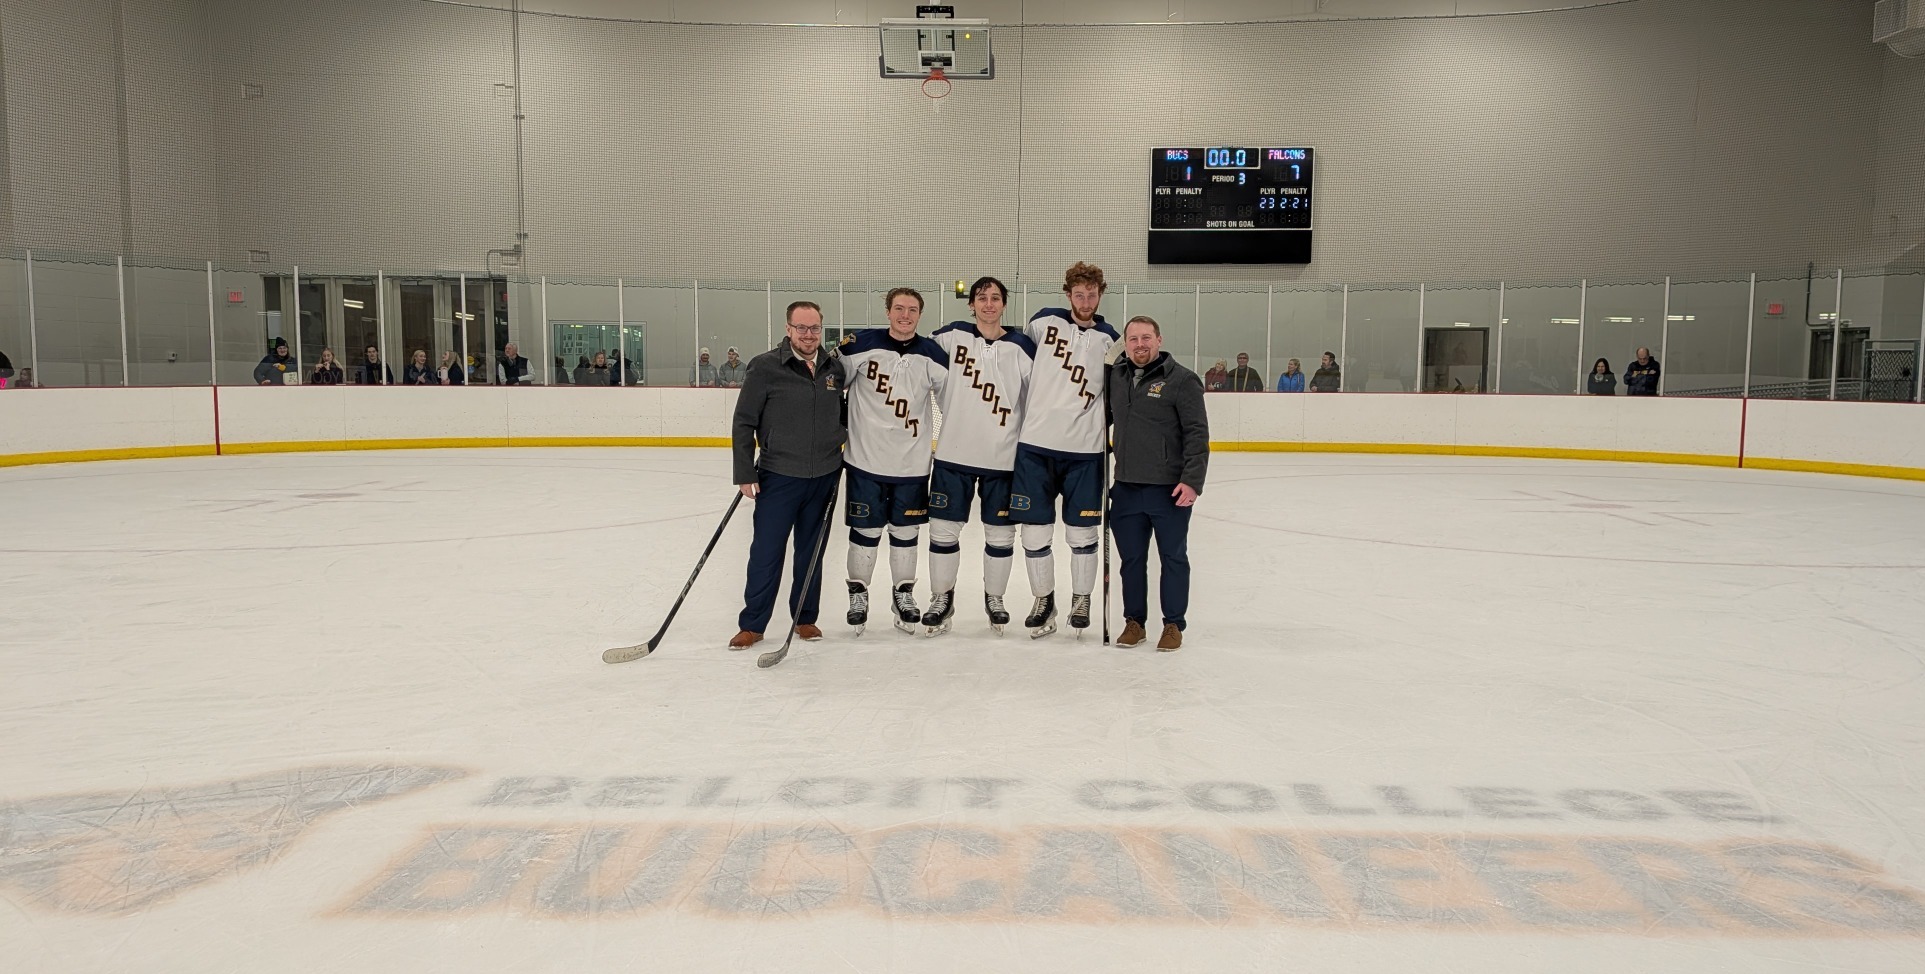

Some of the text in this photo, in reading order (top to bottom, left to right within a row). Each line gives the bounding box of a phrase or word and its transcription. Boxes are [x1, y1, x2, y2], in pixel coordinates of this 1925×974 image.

[1167, 150, 1189, 160] BUCS
[1208, 149, 1246, 166] 00.0
[1268, 149, 1306, 160] FALCONS
[1186, 166, 1192, 181] 1
[1211, 172, 1246, 185] PERIOD 3
[1291, 164, 1300, 180] 7
[1155, 187, 1202, 195] PLYR PENALTY
[1260, 187, 1308, 195] PLYR PENALTY
[1259, 197, 1308, 209] 23 2:21
[1206, 220, 1255, 228] SHOTS ON GOAL
[1044, 325, 1096, 410] BELOIT
[954, 345, 1011, 427] BELOIT
[866, 360, 919, 438] BELOIT
[929, 492, 948, 508] B
[1010, 493, 1031, 511] B
[849, 501, 870, 517] B
[472, 774, 1788, 824] BELOIT COLLEGE
[330, 822, 1925, 938] BUCCANEERS
